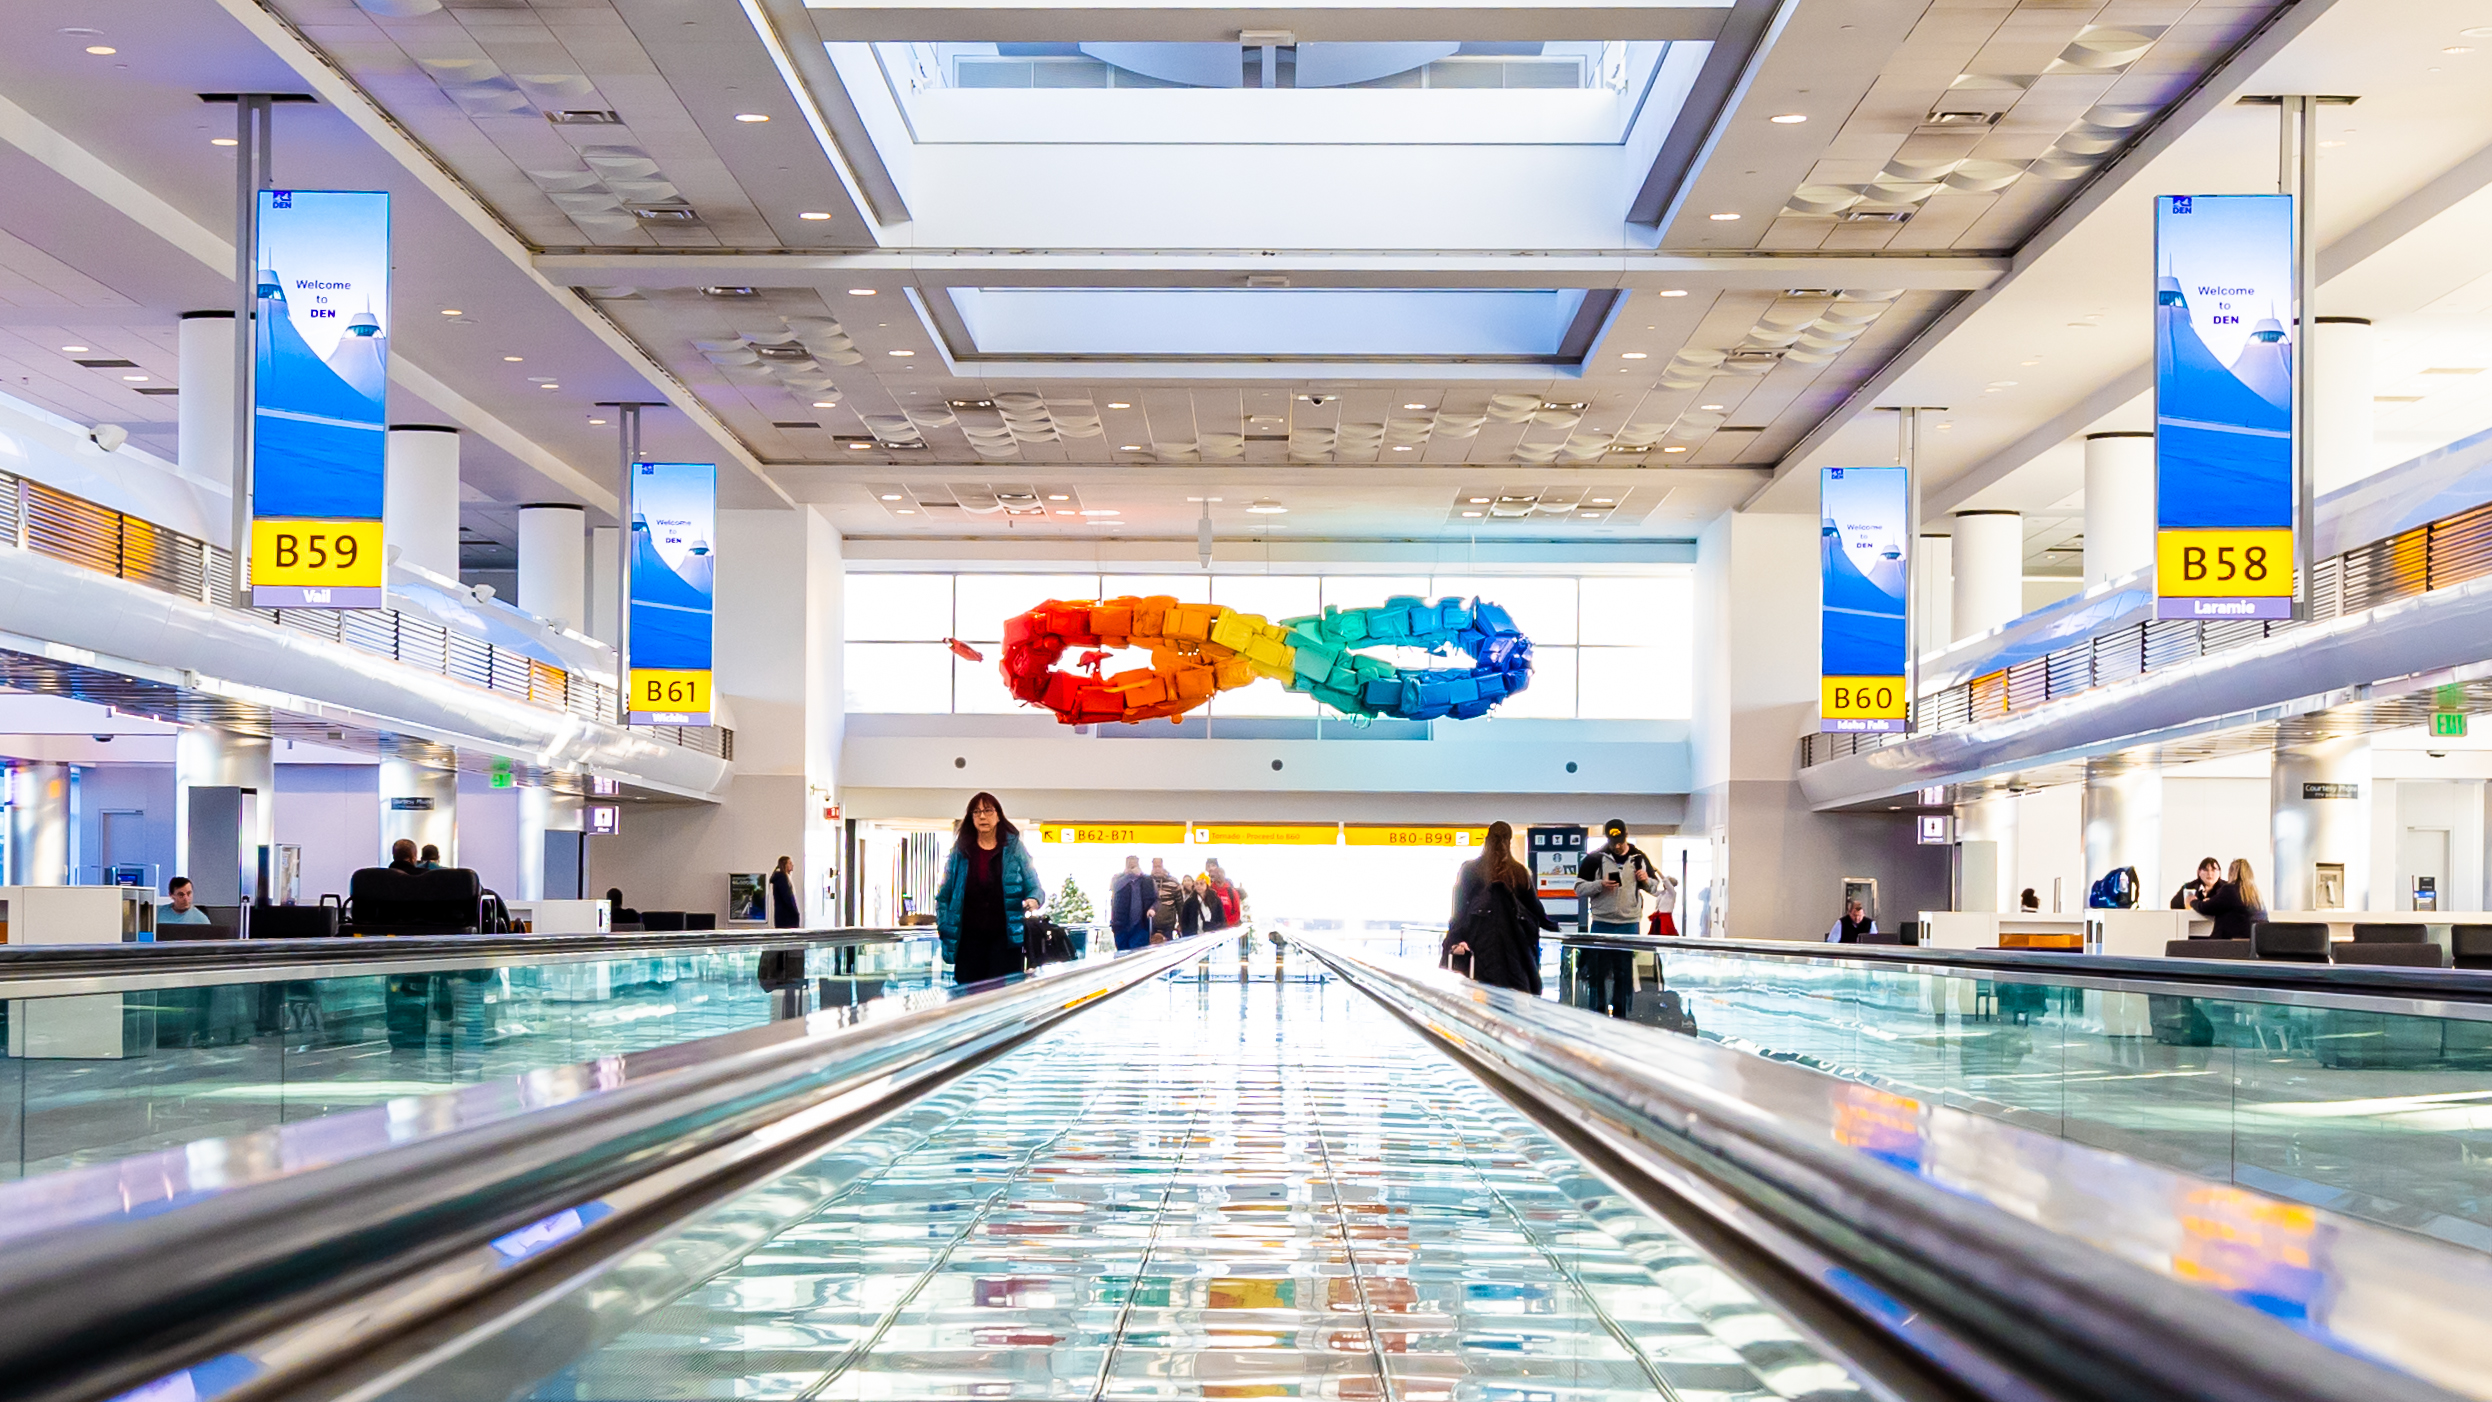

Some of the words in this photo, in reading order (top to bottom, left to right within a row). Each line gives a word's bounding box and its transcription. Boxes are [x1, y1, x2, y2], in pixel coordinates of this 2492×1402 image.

[272, 201, 292, 209] DEN
[296, 279, 351, 290] Welcome
[2198, 286, 2255, 296] Welcome
[316, 295, 328, 304] to
[2219, 302, 2231, 310] to
[310, 309, 336, 318] DEN
[2213, 316, 2239, 325] DEN
[276, 534, 358, 569] B59
[2183, 546, 2268, 582] B58
[303, 588, 331, 604] Vail
[2194, 600, 2256, 615] Laramie
[647, 680, 695, 703] B61
[1835, 687, 1893, 709] B60
[2437, 714, 2464, 735] EXIT
[1078, 830, 1134, 841] B62-B71
[1389, 832, 1452, 844] B80-B99
